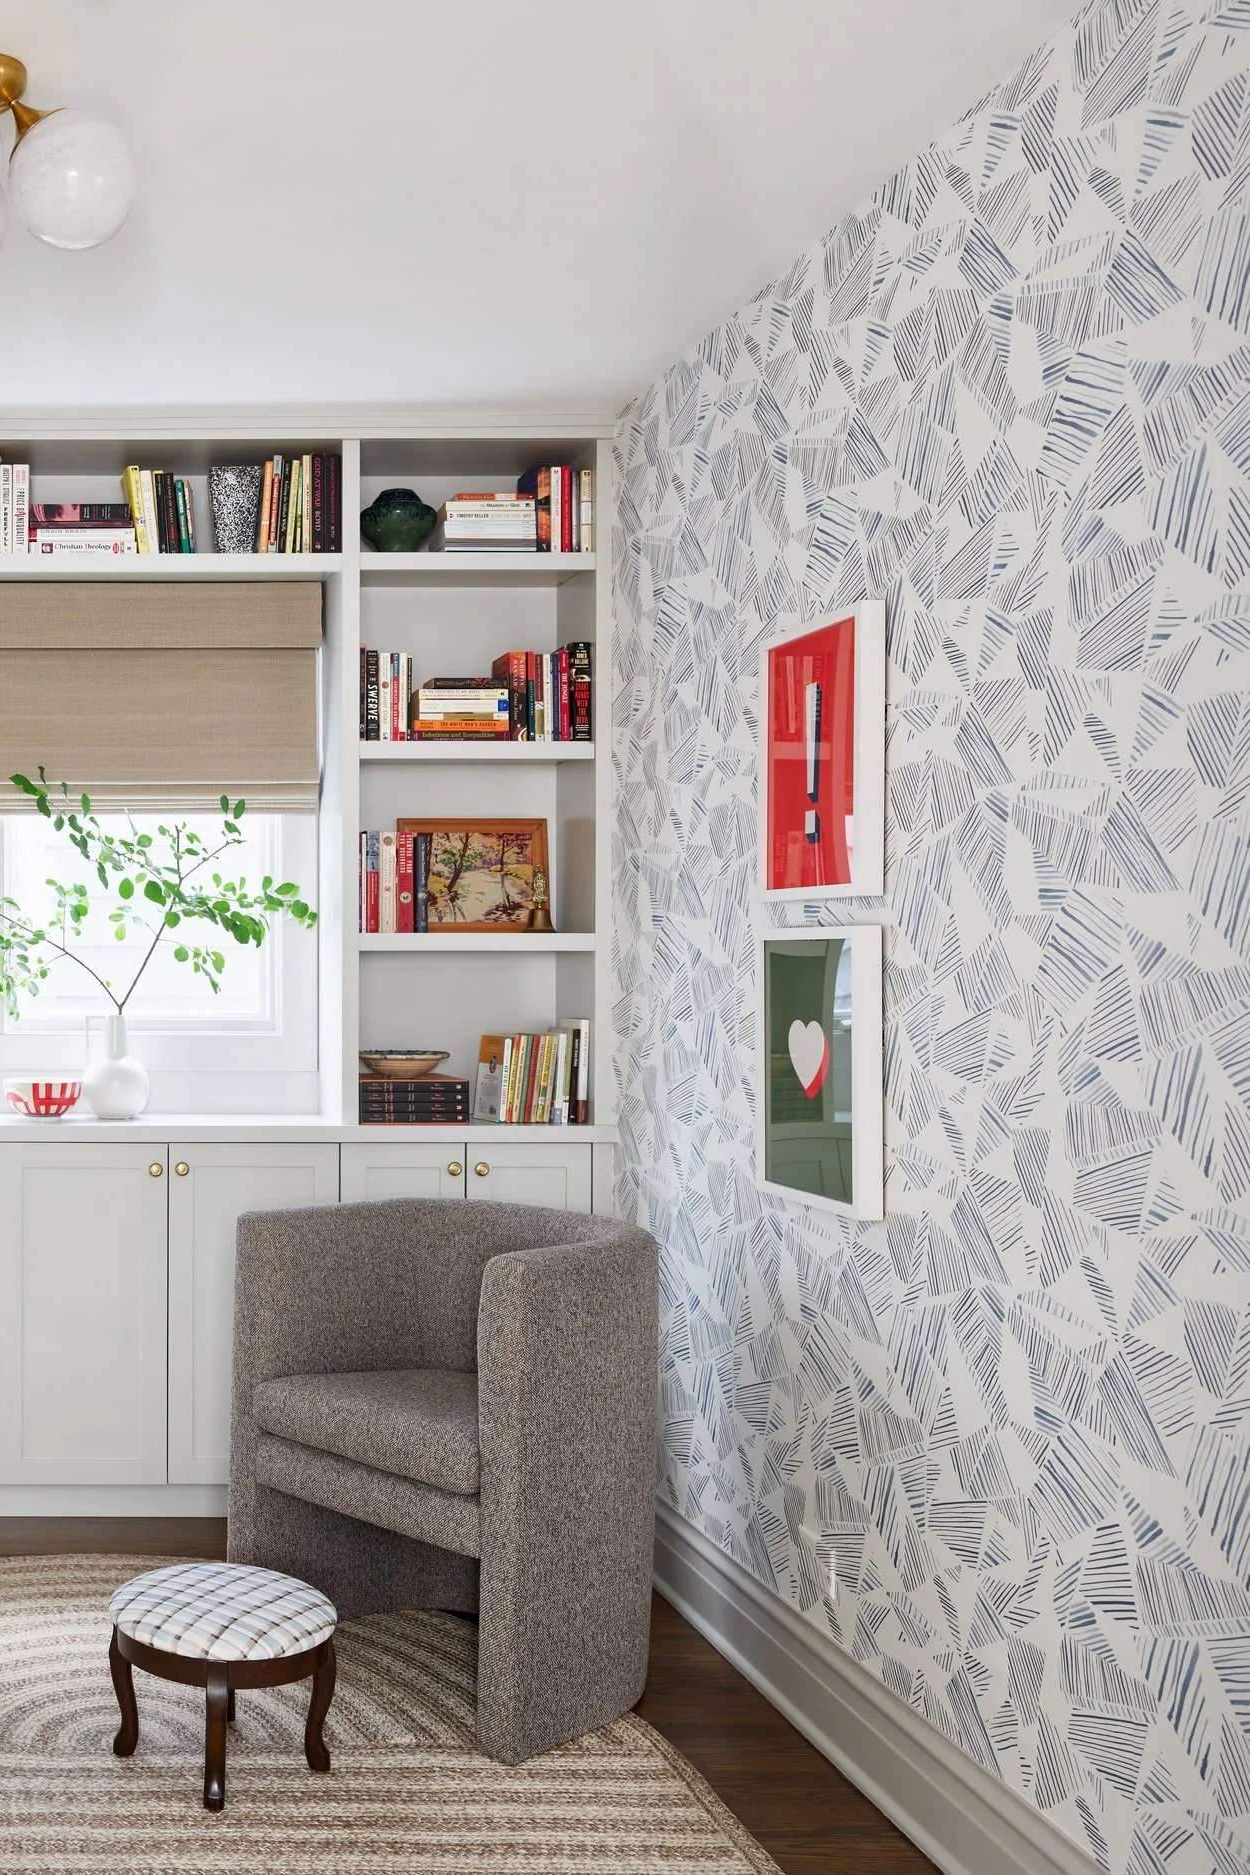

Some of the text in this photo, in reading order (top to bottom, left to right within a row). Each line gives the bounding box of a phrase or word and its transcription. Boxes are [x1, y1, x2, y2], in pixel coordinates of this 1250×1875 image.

[314, 478, 321, 489] AT
[16, 491, 25, 506] PRICE
[575, 682, 589, 691] SHAKE
[575, 691, 590, 699] HANDS
[368, 684, 378, 721] SWERVE
[576, 699, 588, 707] WITH
[578, 707, 587, 716] THE
[576, 716, 589, 724] DEVIL
